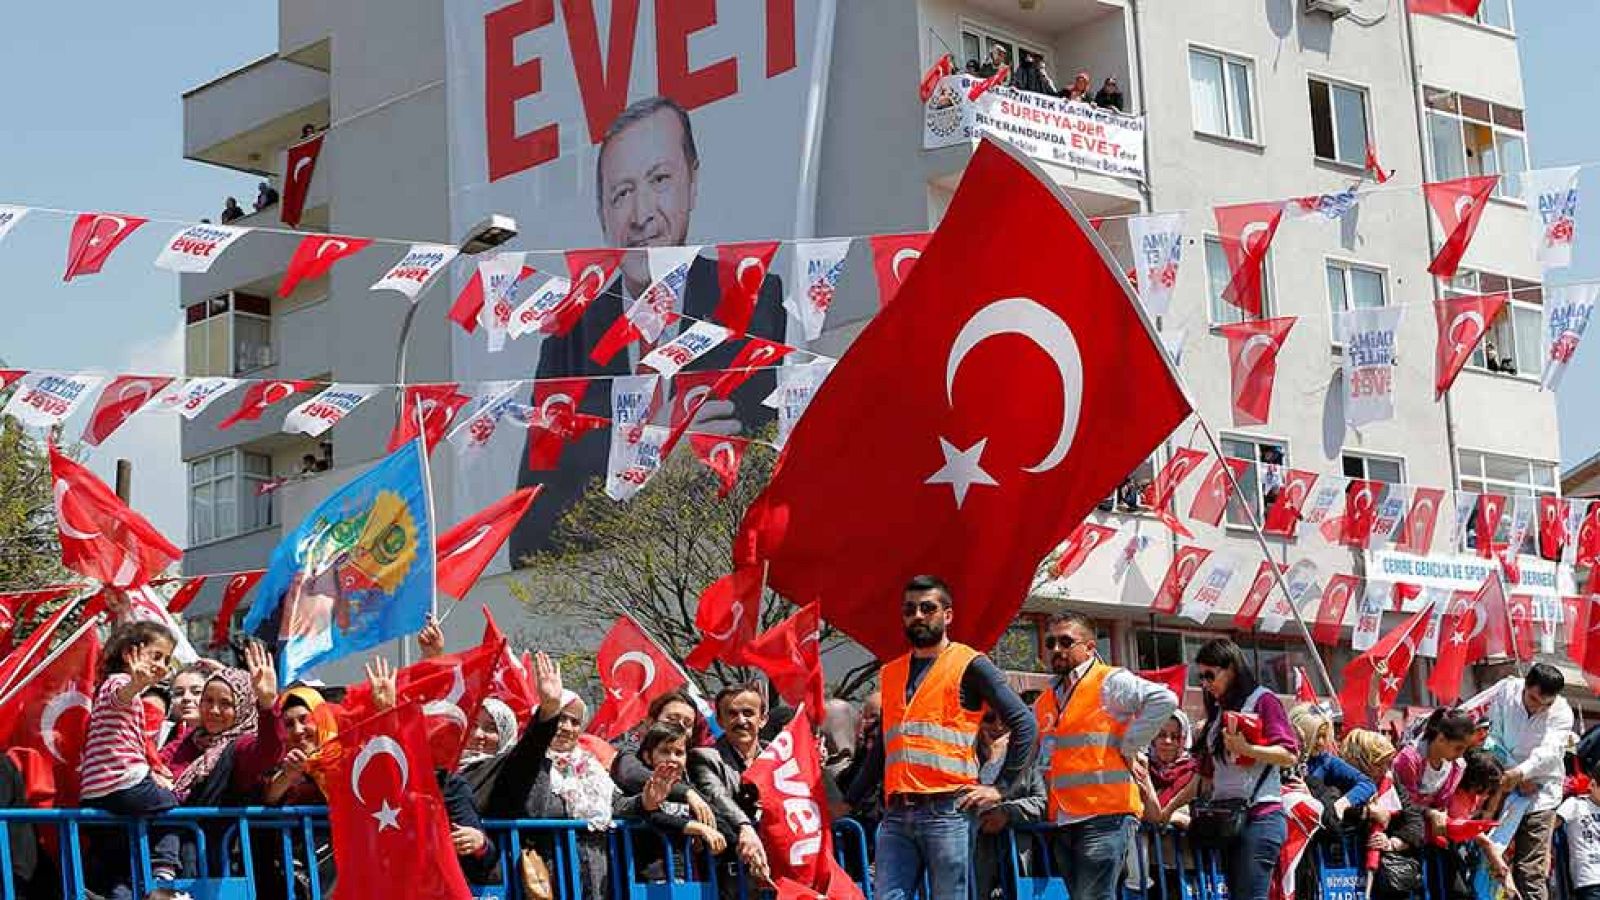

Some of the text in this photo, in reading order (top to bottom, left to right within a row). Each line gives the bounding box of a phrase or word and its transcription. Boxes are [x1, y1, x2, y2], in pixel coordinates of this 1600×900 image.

[1035, 97, 1056, 111] TEK
[1071, 133, 1121, 158] EVET
[170, 236, 216, 258] evet
